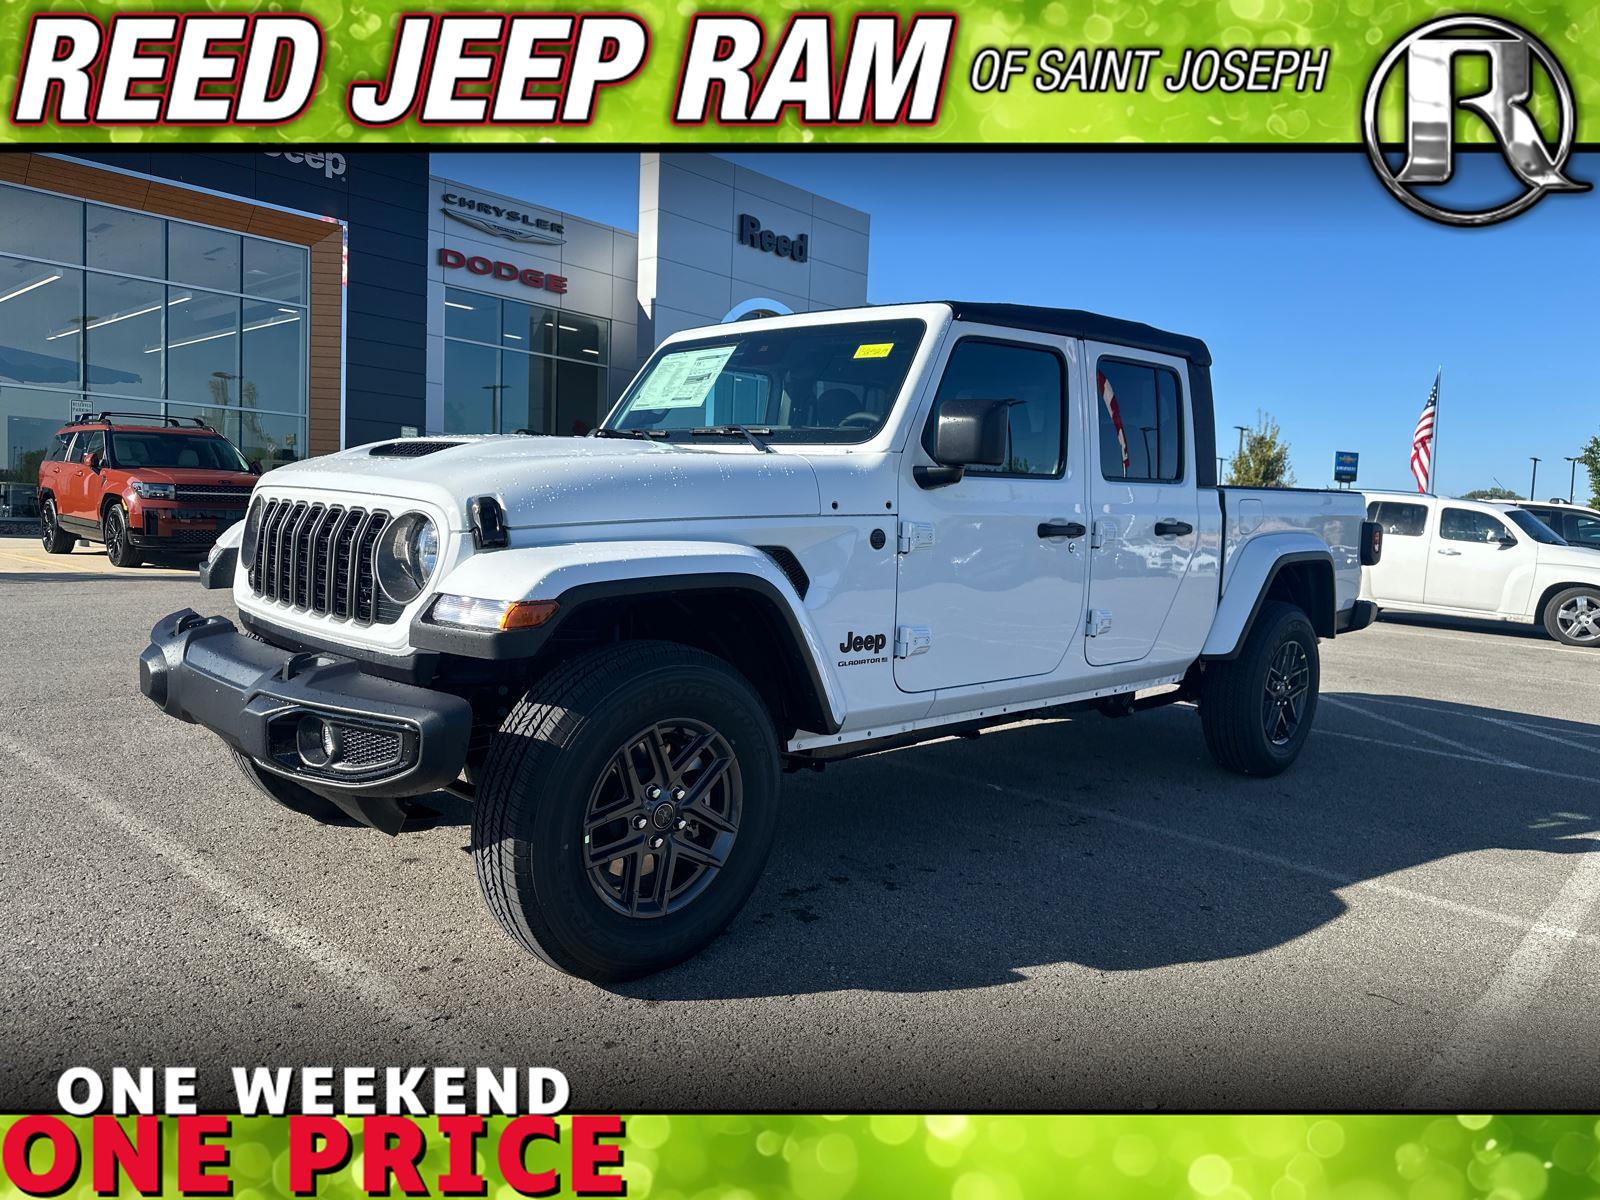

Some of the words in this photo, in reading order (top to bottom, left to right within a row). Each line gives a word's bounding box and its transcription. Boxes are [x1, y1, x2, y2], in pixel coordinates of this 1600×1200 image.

[440, 192, 565, 236] CHRYSLER
[738, 213, 808, 263] Reed
[438, 248, 568, 295] DODGE
[837, 657, 881, 668] GLADIATOR
[839, 631, 887, 654] Jeep
